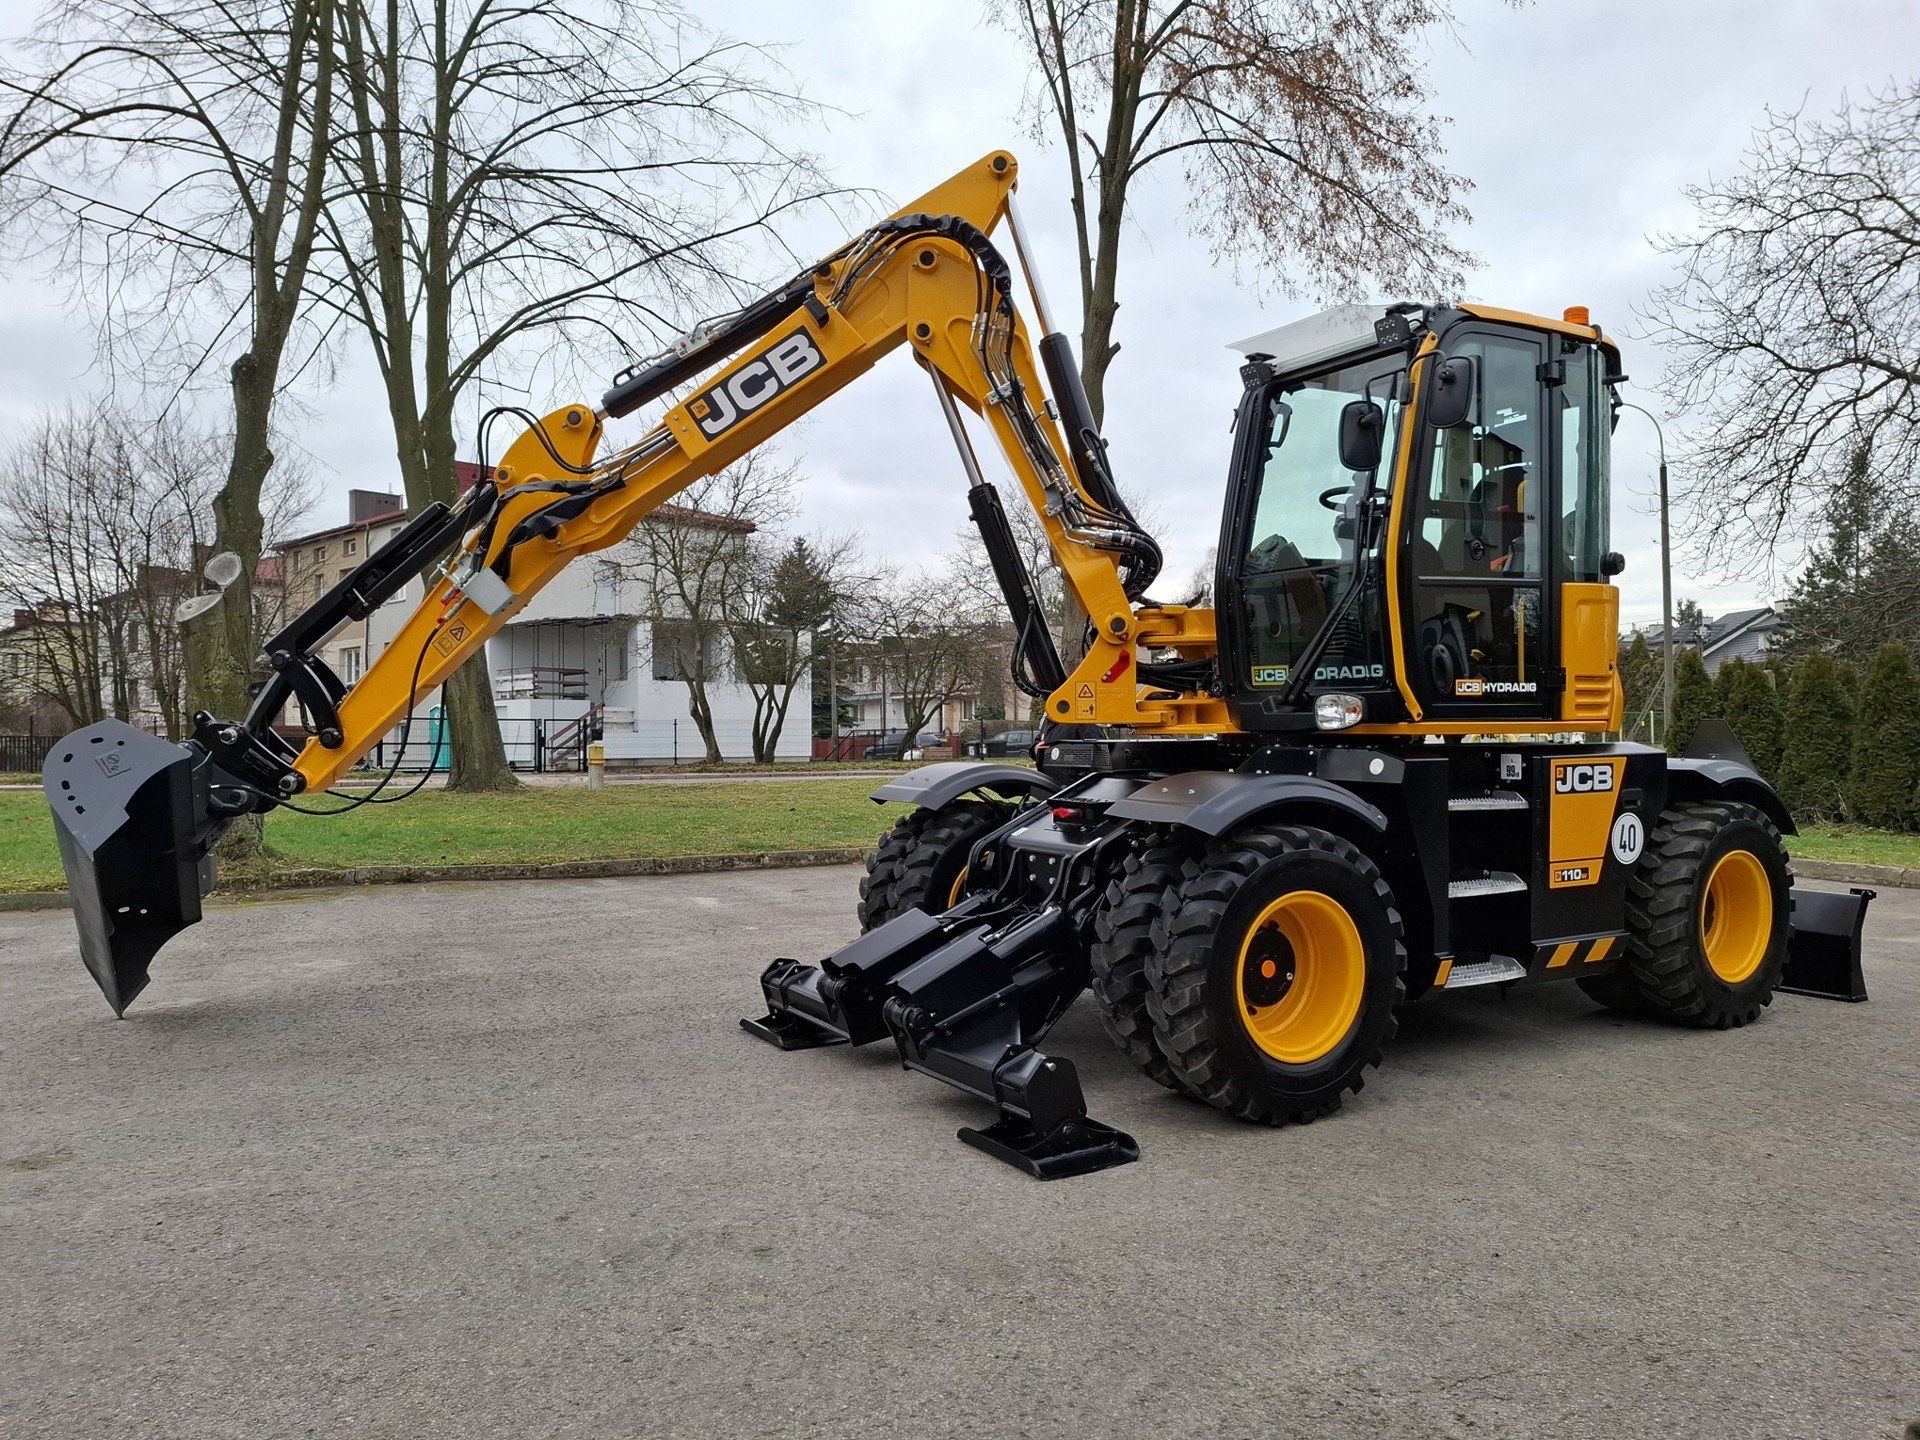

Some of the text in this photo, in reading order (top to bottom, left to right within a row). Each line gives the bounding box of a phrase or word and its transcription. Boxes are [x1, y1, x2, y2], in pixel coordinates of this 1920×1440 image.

[701, 334, 820, 434] JCB
[1255, 664, 1384, 682] JCB DRADIG
[1458, 682, 1537, 693] JCB HYDRADIG
[1556, 765, 1613, 793] JCB
[1619, 823, 1637, 853] 40
